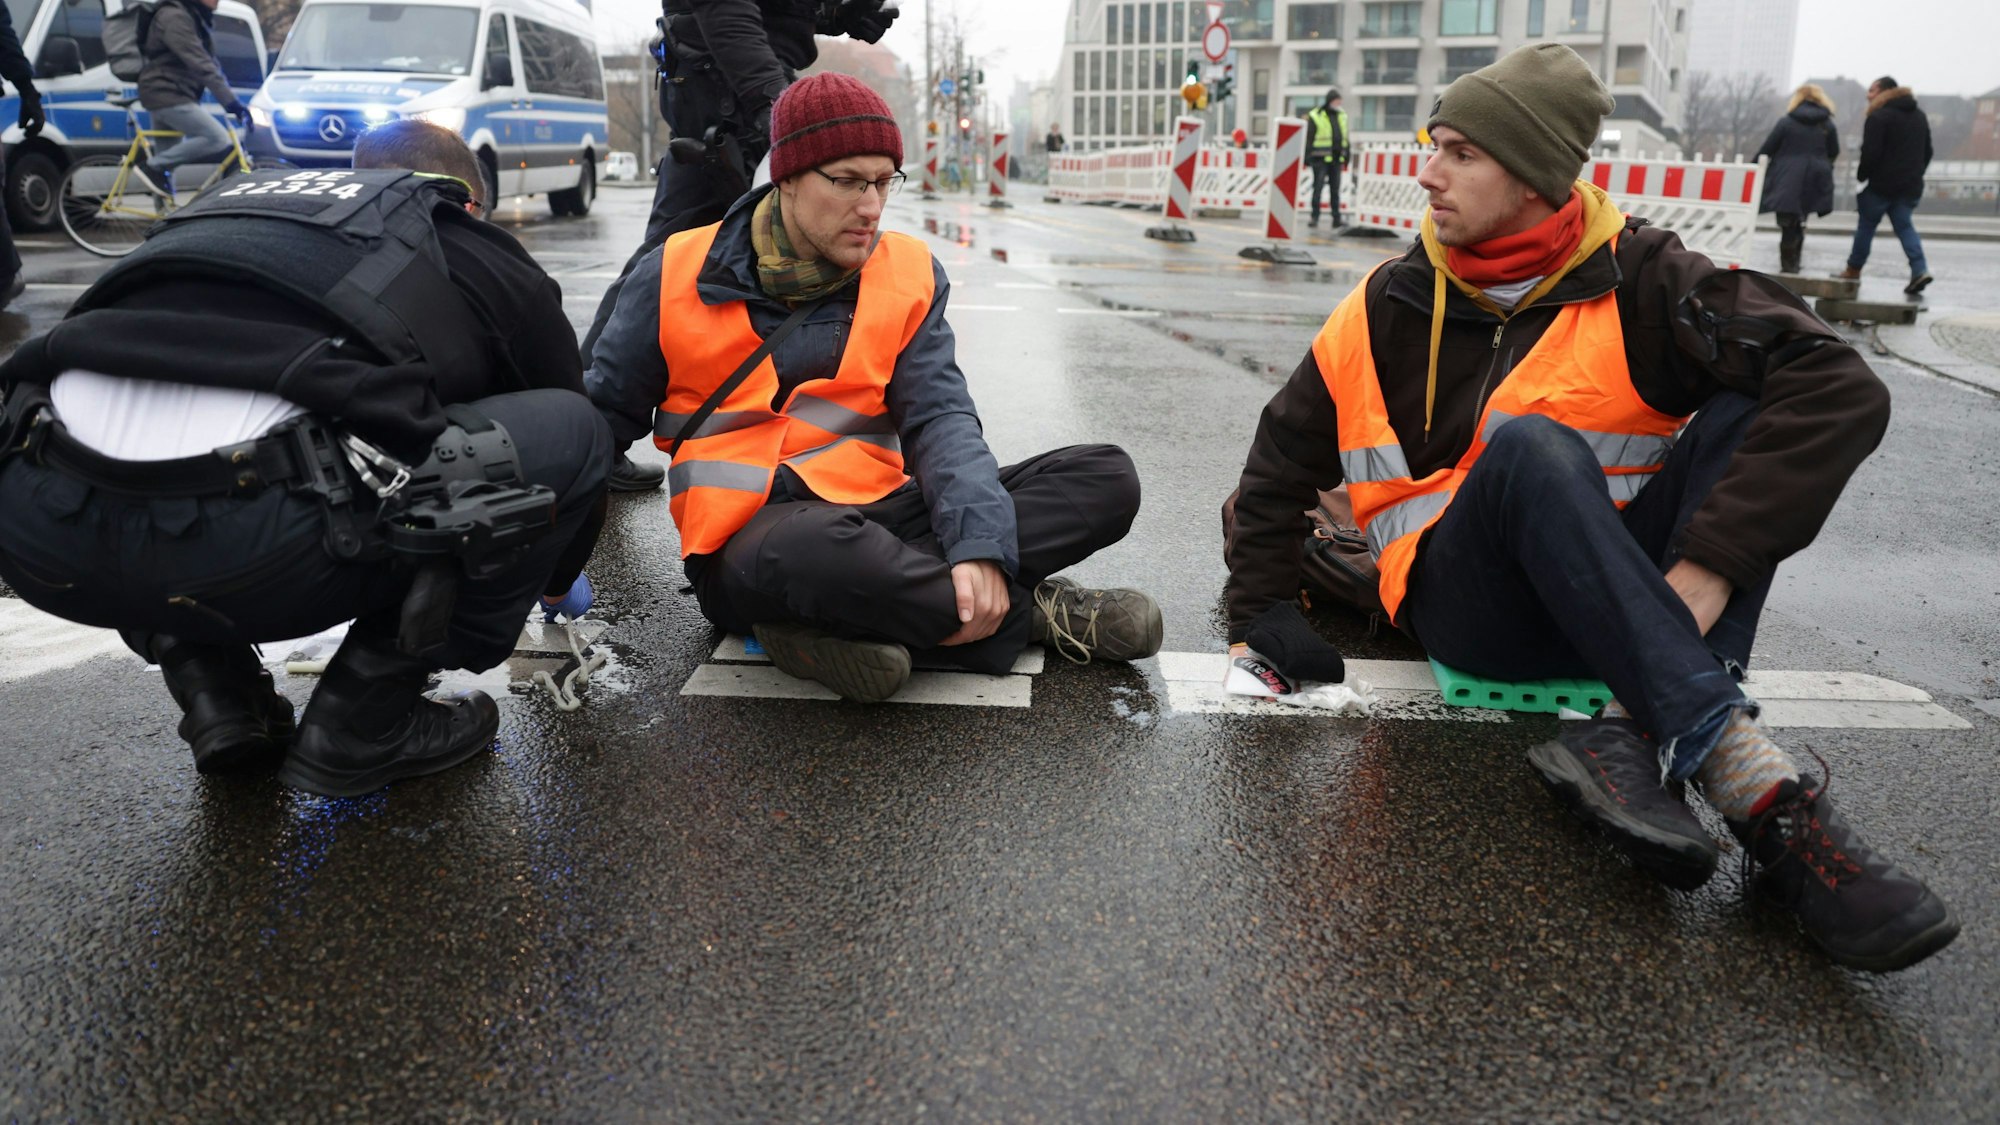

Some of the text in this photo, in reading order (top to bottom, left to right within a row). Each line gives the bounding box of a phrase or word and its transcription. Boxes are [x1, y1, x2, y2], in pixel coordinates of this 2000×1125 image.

[297, 83, 392, 96] POLIZEI
[283, 171, 356, 181] BE
[219, 181, 364, 200] 22324
[1240, 658, 1287, 693] firebag
